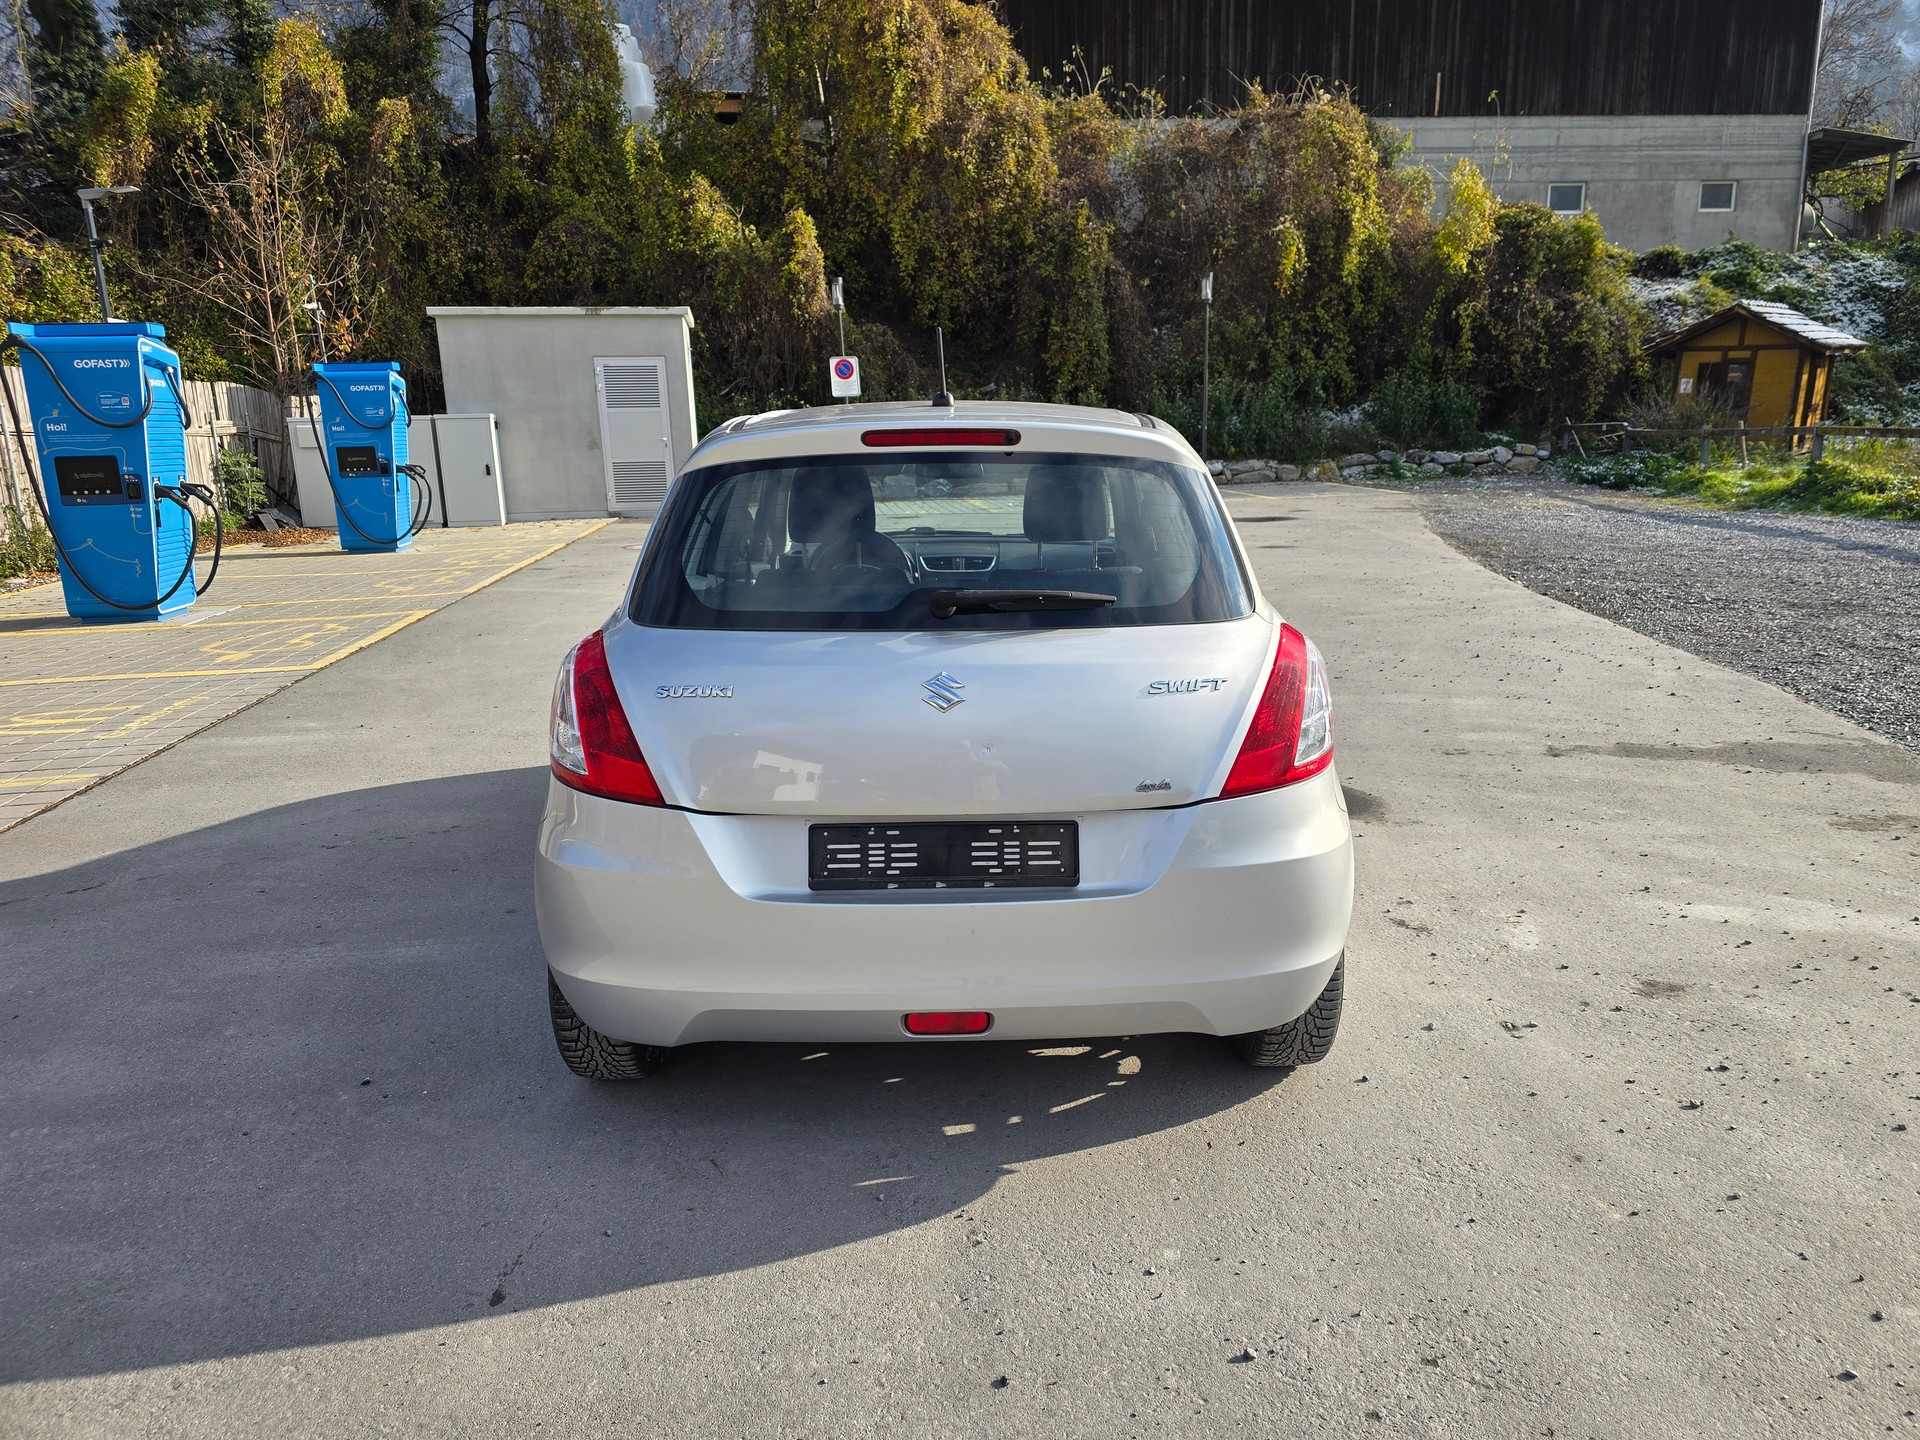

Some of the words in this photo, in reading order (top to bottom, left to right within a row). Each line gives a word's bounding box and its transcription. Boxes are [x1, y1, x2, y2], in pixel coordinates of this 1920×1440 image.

[73, 359, 119, 368] GOFAST
[46, 423, 68, 431] Hoi!
[655, 684, 734, 699] SUZUKI
[1148, 676, 1228, 695] SWIFT
